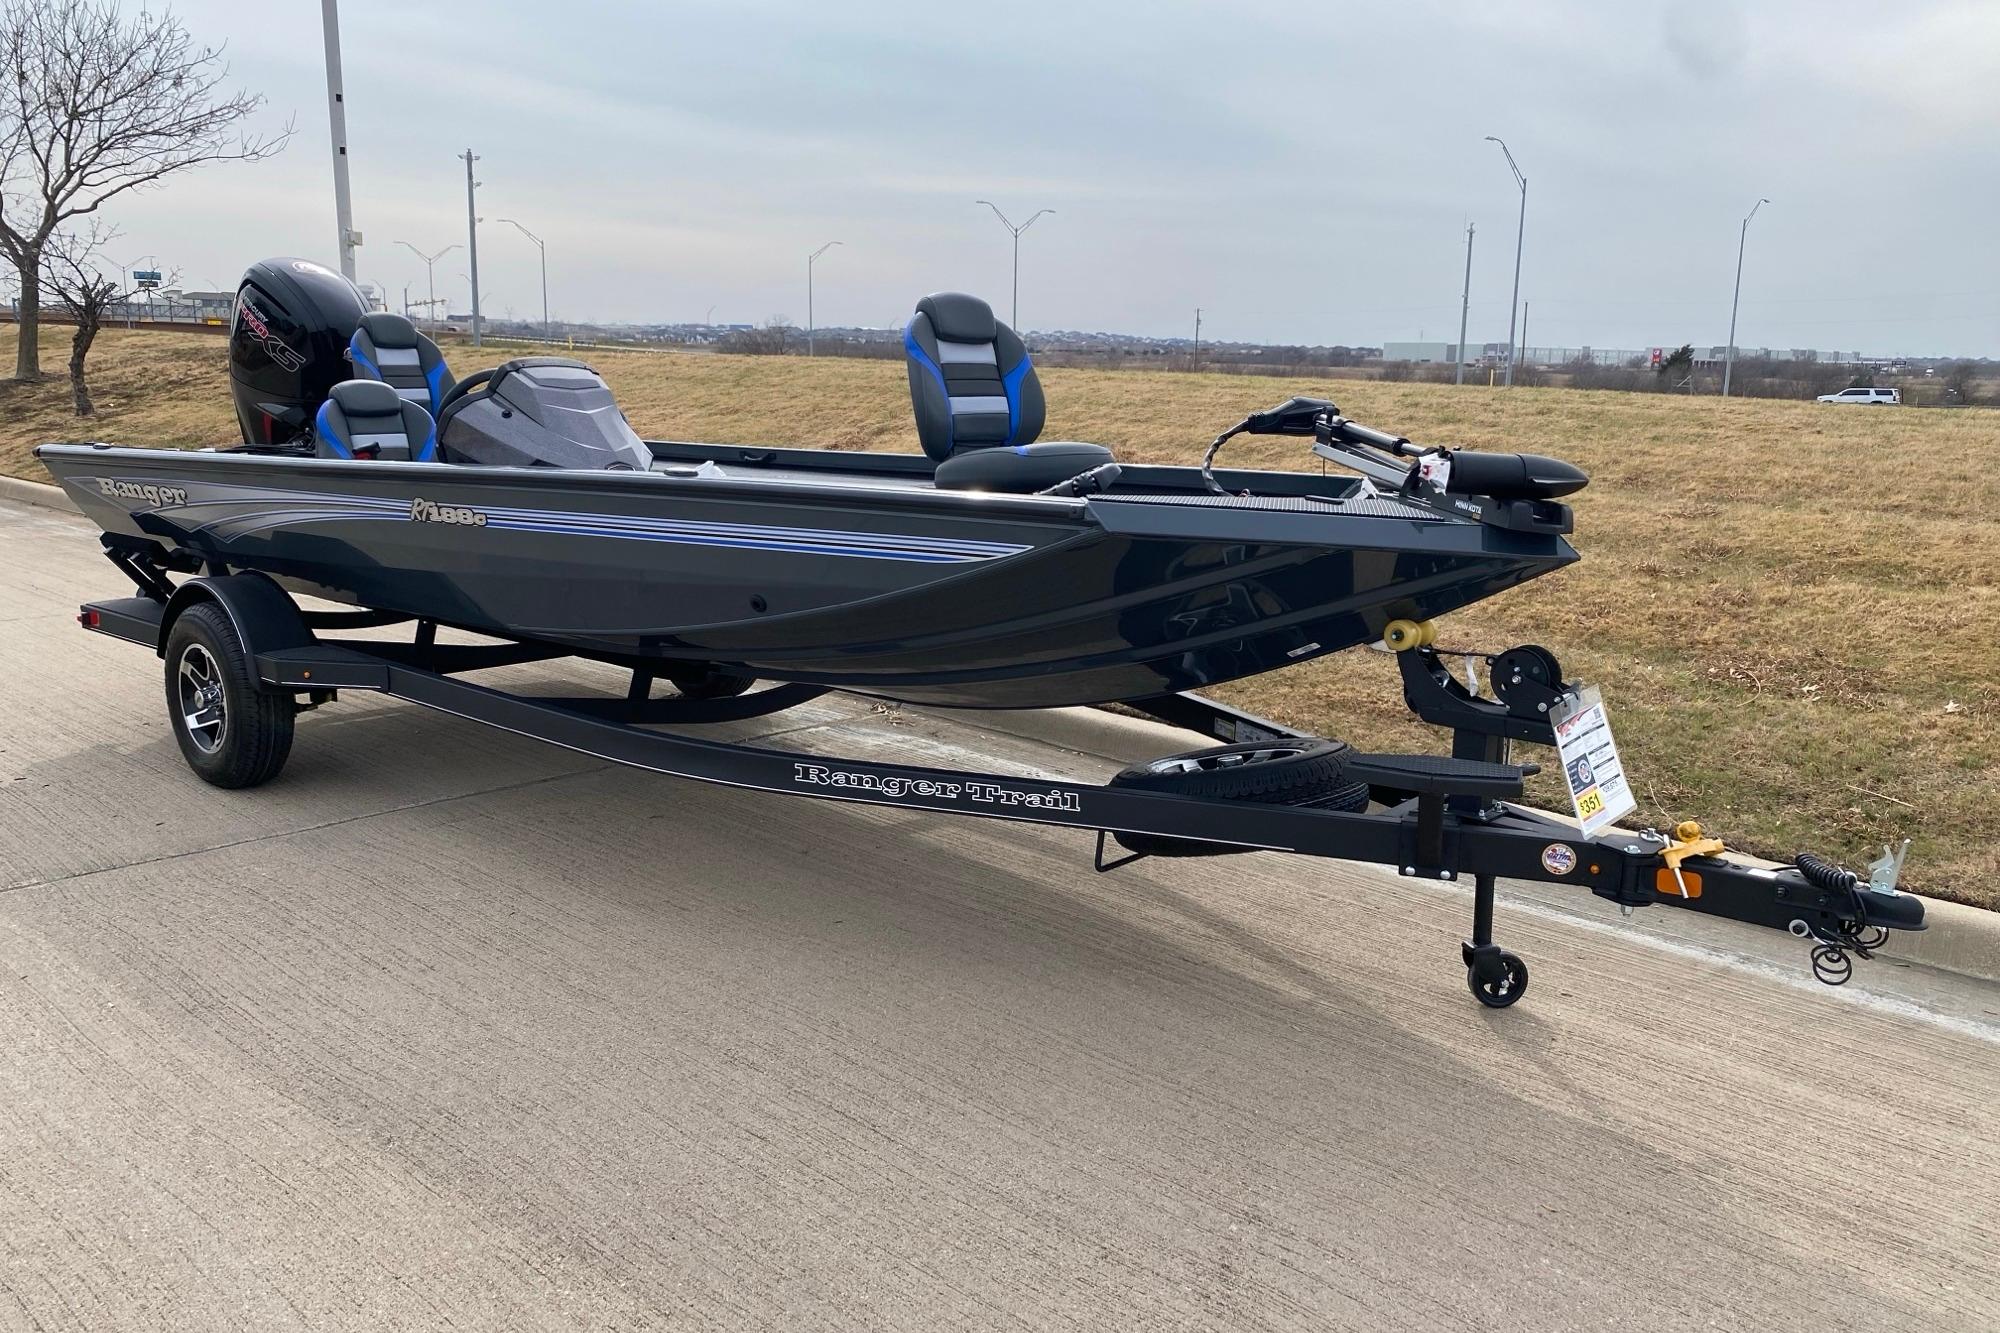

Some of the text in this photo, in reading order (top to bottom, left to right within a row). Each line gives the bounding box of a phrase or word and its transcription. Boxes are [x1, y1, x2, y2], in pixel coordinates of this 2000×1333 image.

[248, 332, 306, 372] XS
[96, 477, 187, 508] Ranger
[1468, 502, 1482, 514] KOTA
[795, 763, 1080, 812] Ranger Trail
[1579, 792, 1601, 814] $351
